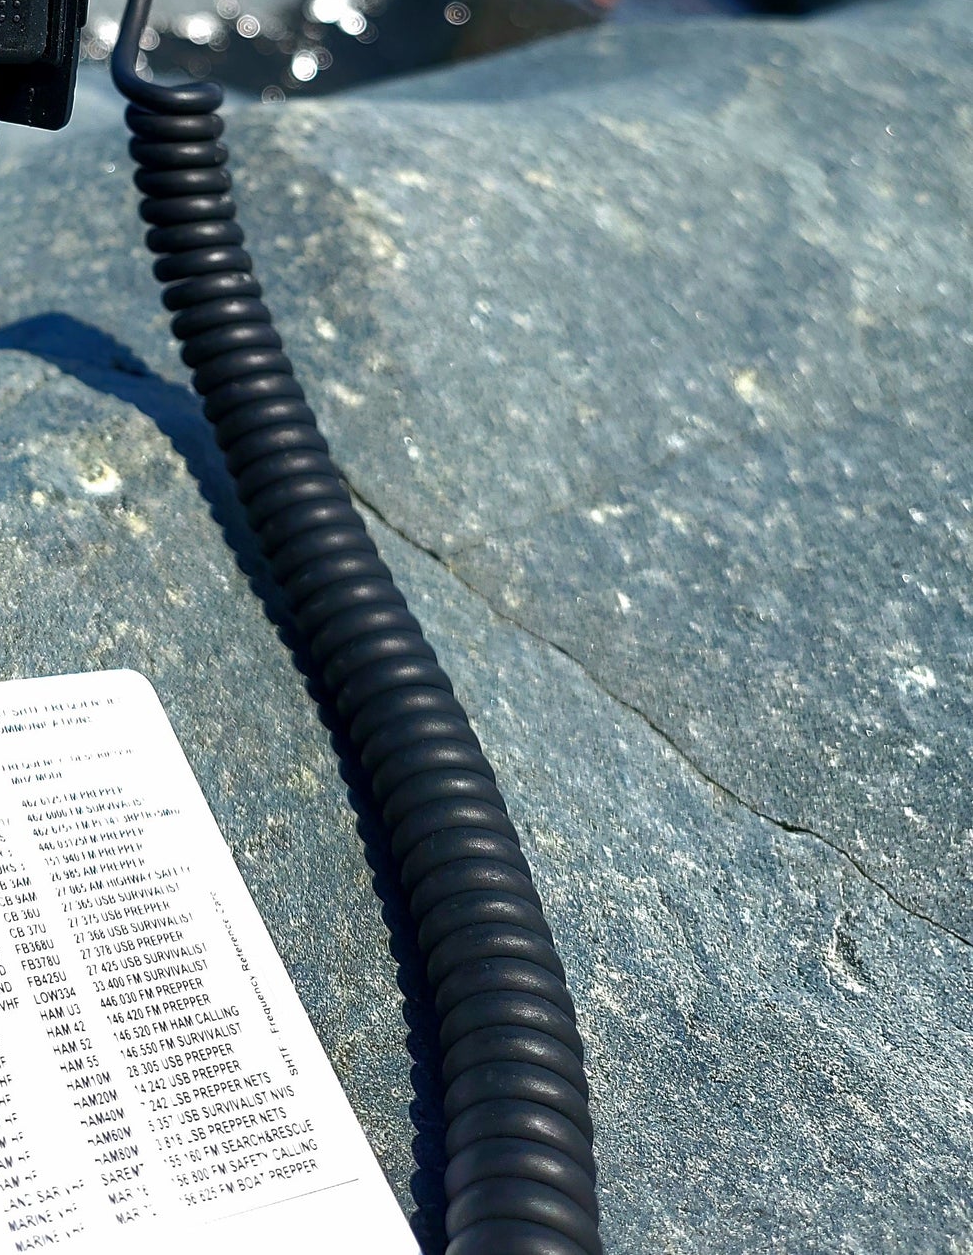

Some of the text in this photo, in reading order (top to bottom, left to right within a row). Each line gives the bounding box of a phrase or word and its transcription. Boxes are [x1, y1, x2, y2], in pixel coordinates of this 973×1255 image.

[84, 865, 98, 876] AM
[90, 880, 104, 891] AM
[95, 895, 116, 906] USB
[4, 908, 40, 922] CB 36U
[101, 910, 122, 921] USB
[9, 924, 46, 938] CB 37U
[107, 925, 129, 937] USB
[15, 939, 54, 954] FB368U
[113, 931, 184, 953] USB PREPPER
[21, 955, 60, 970] FB378U
[120, 944, 206, 969] USB SURVIVALIST
[27, 971, 66, 987] FB425U
[126, 973, 142, 985] FM
[144, 960, 207, 982] SURVIVALIST
[34, 987, 76, 1004] LOW334
[101, 979, 204, 1008] 446.030 FM PREPPER
[40, 1004, 81, 1020] HAM U3
[107, 995, 211, 1024] 146.420 FM PREPPER
[249, 975, 280, 1034] Frequency
[46, 1021, 86, 1038] HAM 42
[113, 1006, 239, 1042] 146.520 FM HAM CALLING
[53, 1038, 93, 1055] HAM 52
[120, 1024, 242, 1058] 146.550 FM SURVIVALIST
[60, 1055, 99, 1073] HAM 55
[161, 1055, 183, 1069] USB
[185, 1044, 234, 1064] PREPPER
[278, 1045, 299, 1077] SHTF
[168, 1061, 242, 1087] USB PREPPER
[192, 1079, 243, 1099] PREPPER
[243, 1072, 271, 1087] NETS
[177, 1086, 294, 1124] USB SURVIVALIST NVIS
[208, 1107, 286, 1134] PREPPER NETS
[221, 1119, 314, 1153] SEARCH&RESCUE
[272, 1139, 317, 1160] CALLING
